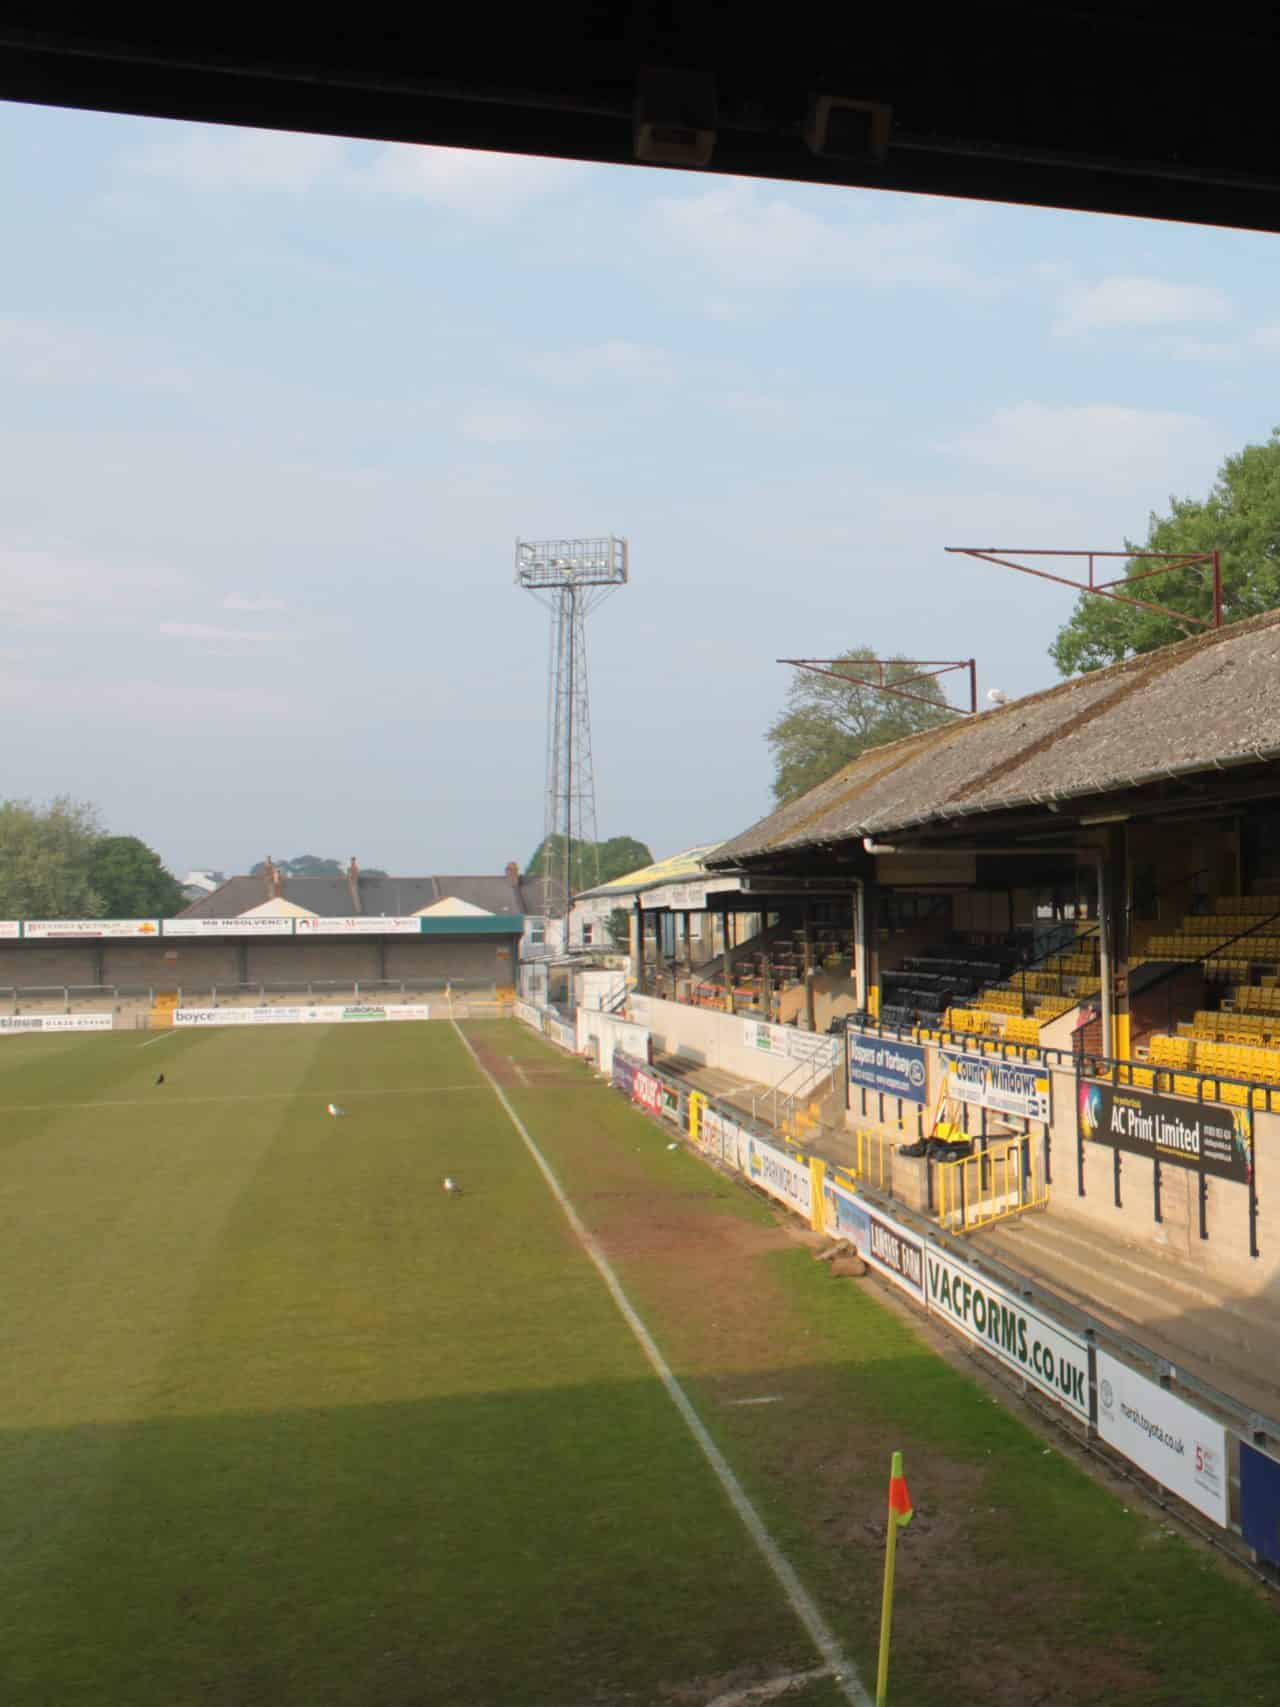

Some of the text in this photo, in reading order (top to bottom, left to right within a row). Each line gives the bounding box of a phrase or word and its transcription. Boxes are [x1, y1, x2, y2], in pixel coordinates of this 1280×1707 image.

[956, 1056, 1037, 1097] County Windows
[1111, 1105, 1126, 1134] AC
[1128, 1108, 1153, 1143] Print
[1155, 1114, 1200, 1153] Limited
[928, 1258, 1085, 1406] VACFORMS.CO.UK
[1195, 1445, 1204, 1472] 5
